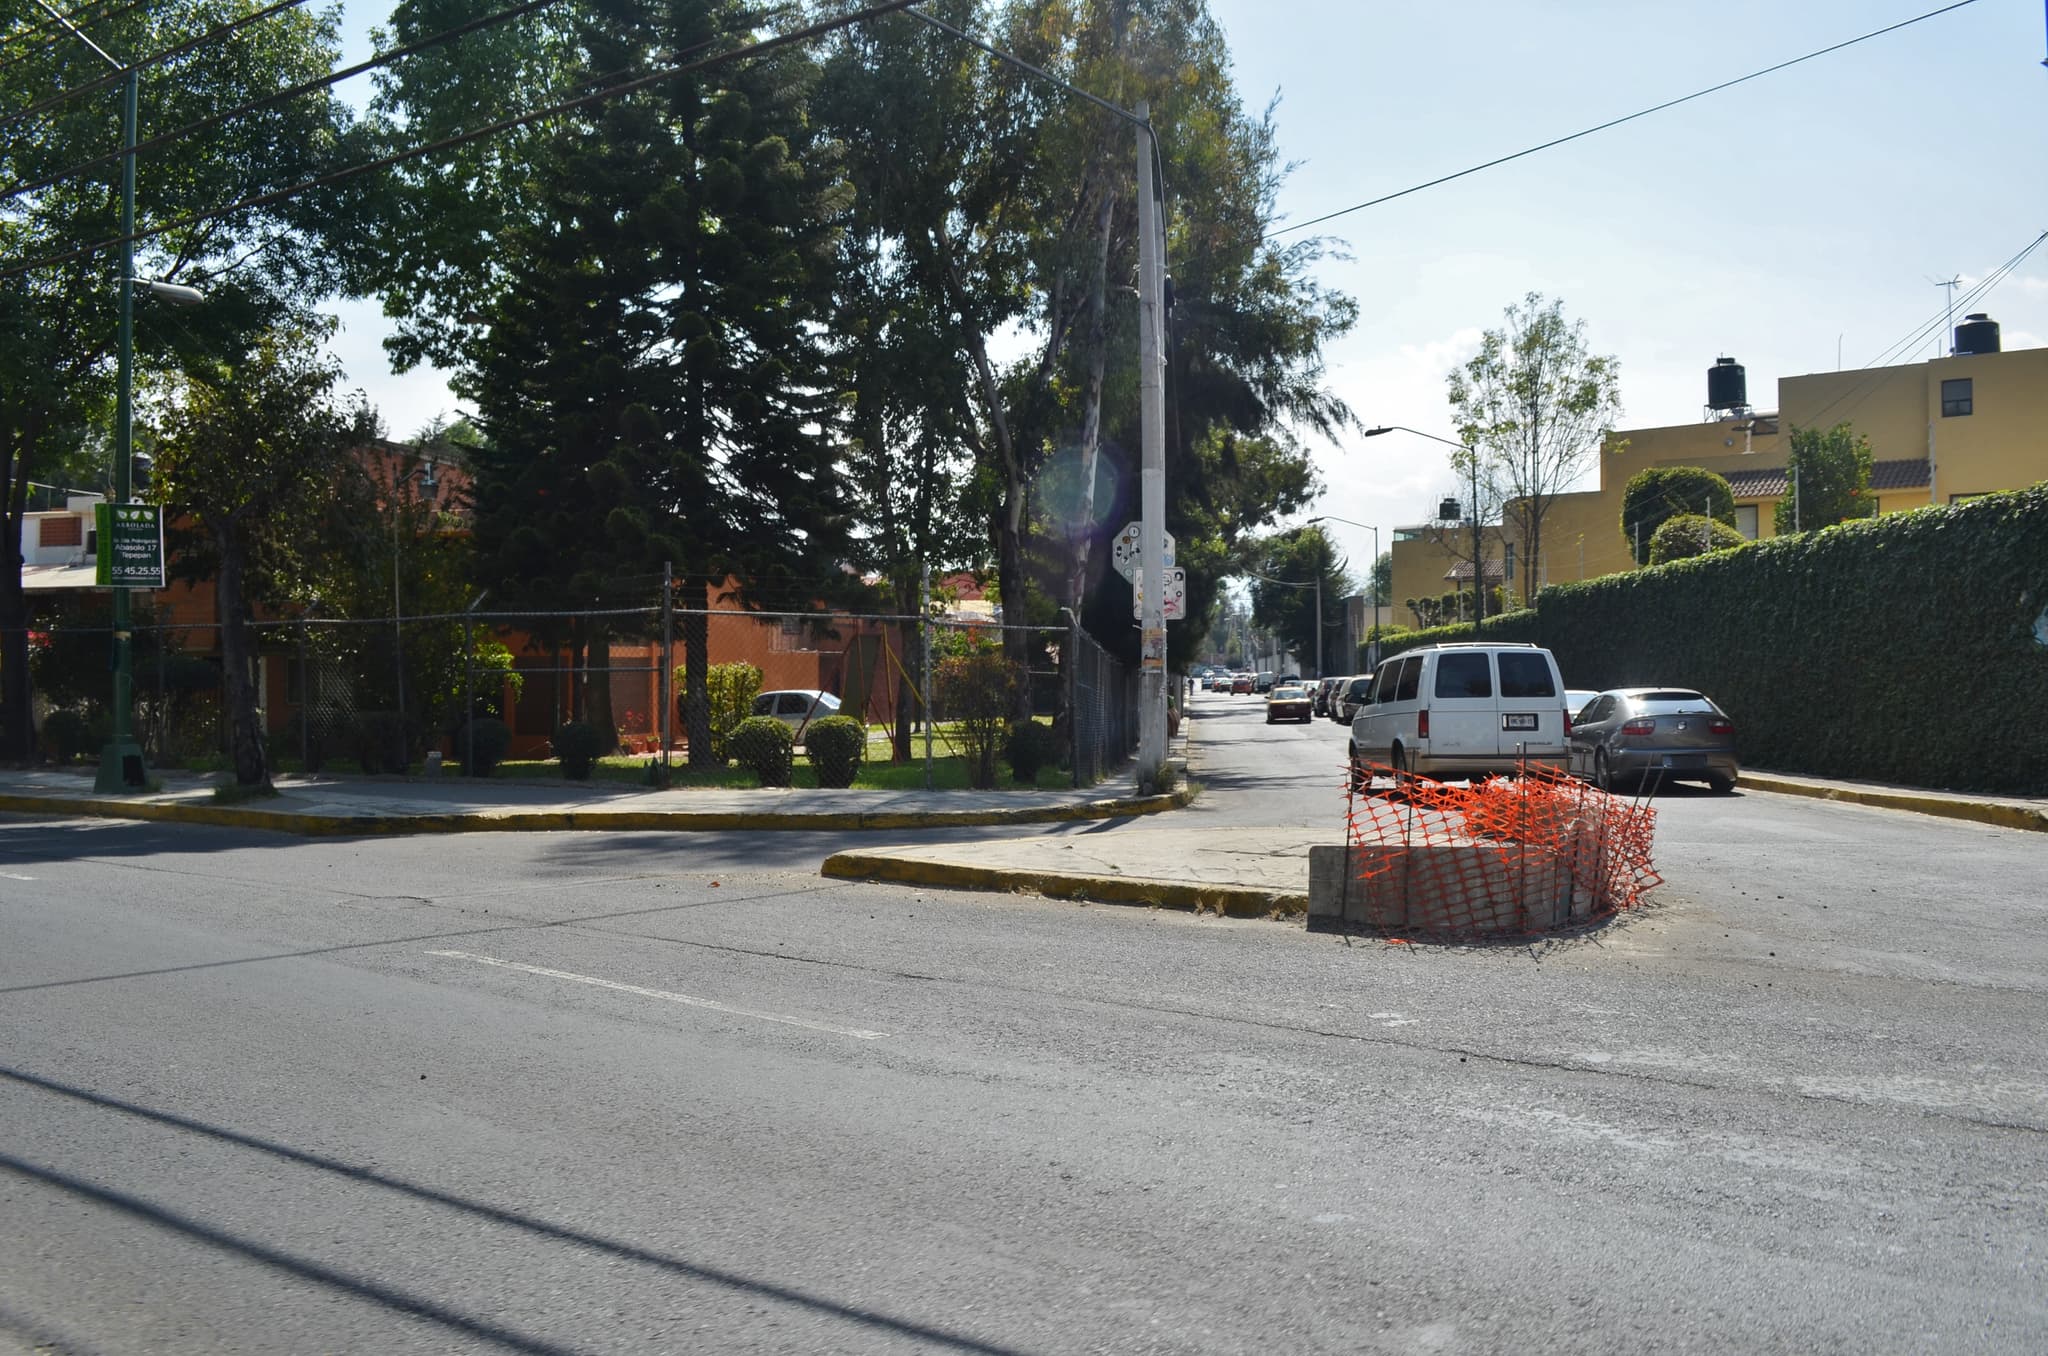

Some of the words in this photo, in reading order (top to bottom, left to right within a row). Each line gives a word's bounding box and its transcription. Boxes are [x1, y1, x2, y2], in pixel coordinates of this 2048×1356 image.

[115, 543, 145, 551] Abasolo
[121, 551, 151, 559] Tepepan
[112, 566, 123, 575] 55
[124, 566, 161, 575] 45.25.55
